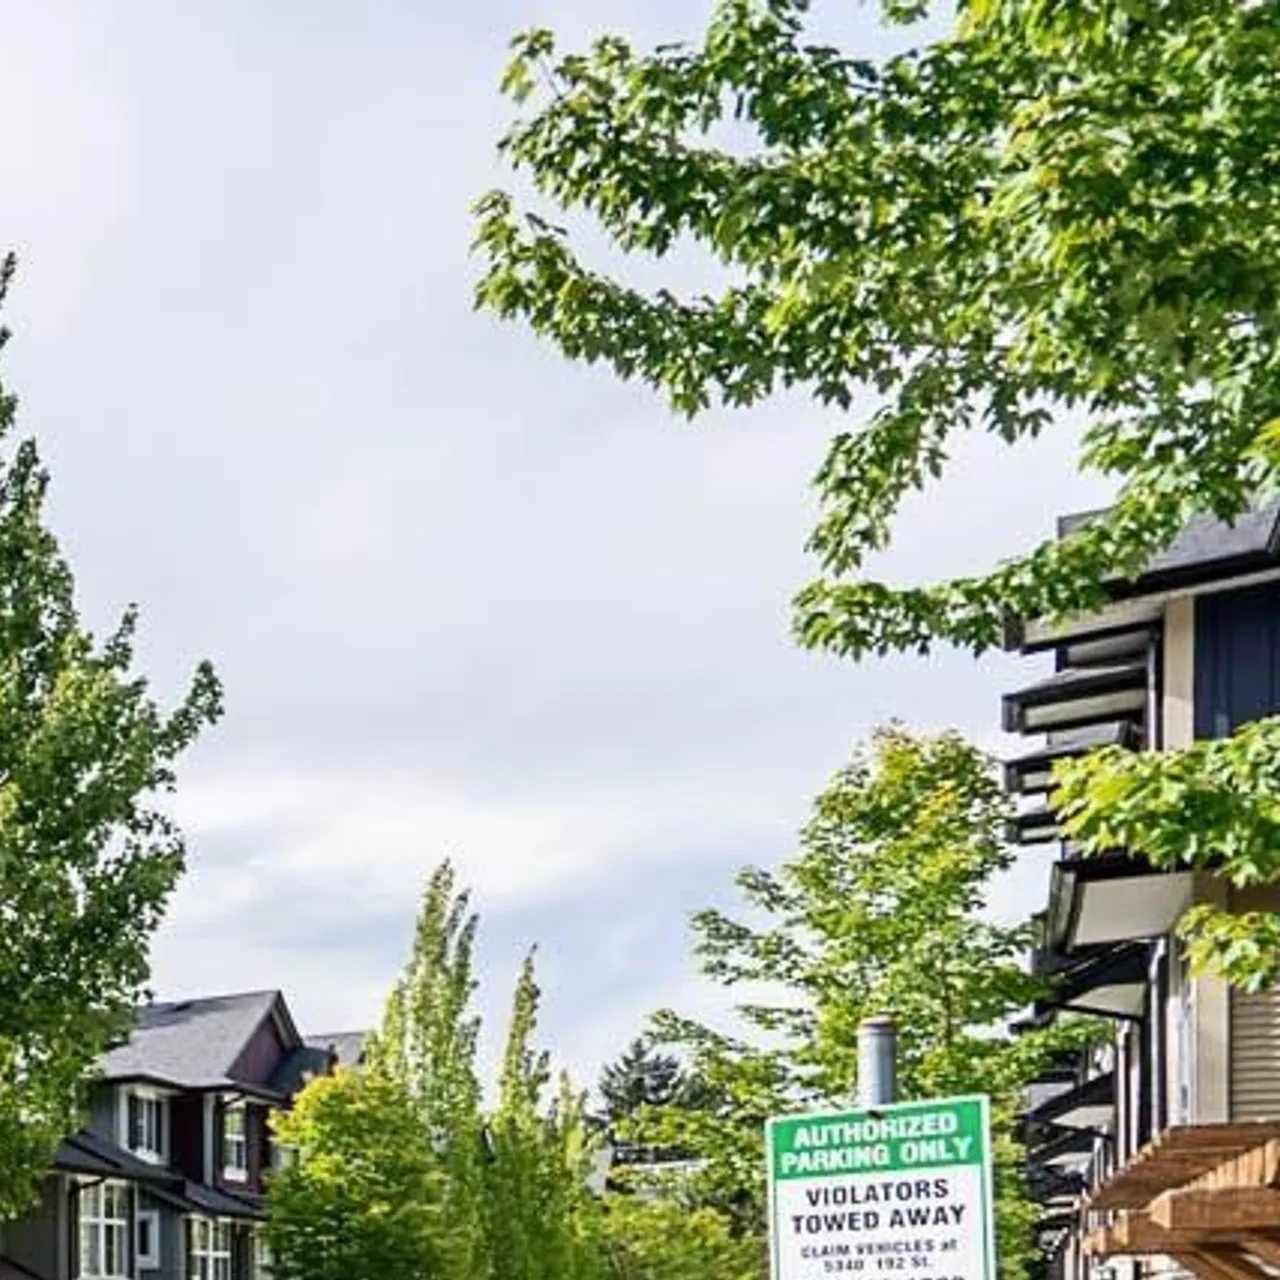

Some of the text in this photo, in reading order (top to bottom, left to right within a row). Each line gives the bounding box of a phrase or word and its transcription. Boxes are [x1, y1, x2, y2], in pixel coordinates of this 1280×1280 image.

[793, 1112, 958, 1148] AUTHORIZED
[781, 1136, 973, 1174] PARKING ONLY
[806, 1179, 949, 1207] VIOLATORS
[792, 1204, 965, 1234] TOWED AWAY
[801, 1243, 850, 1258] CLAIM
[856, 1239, 935, 1255] VEHICLES
[877, 1257, 905, 1270] 192
